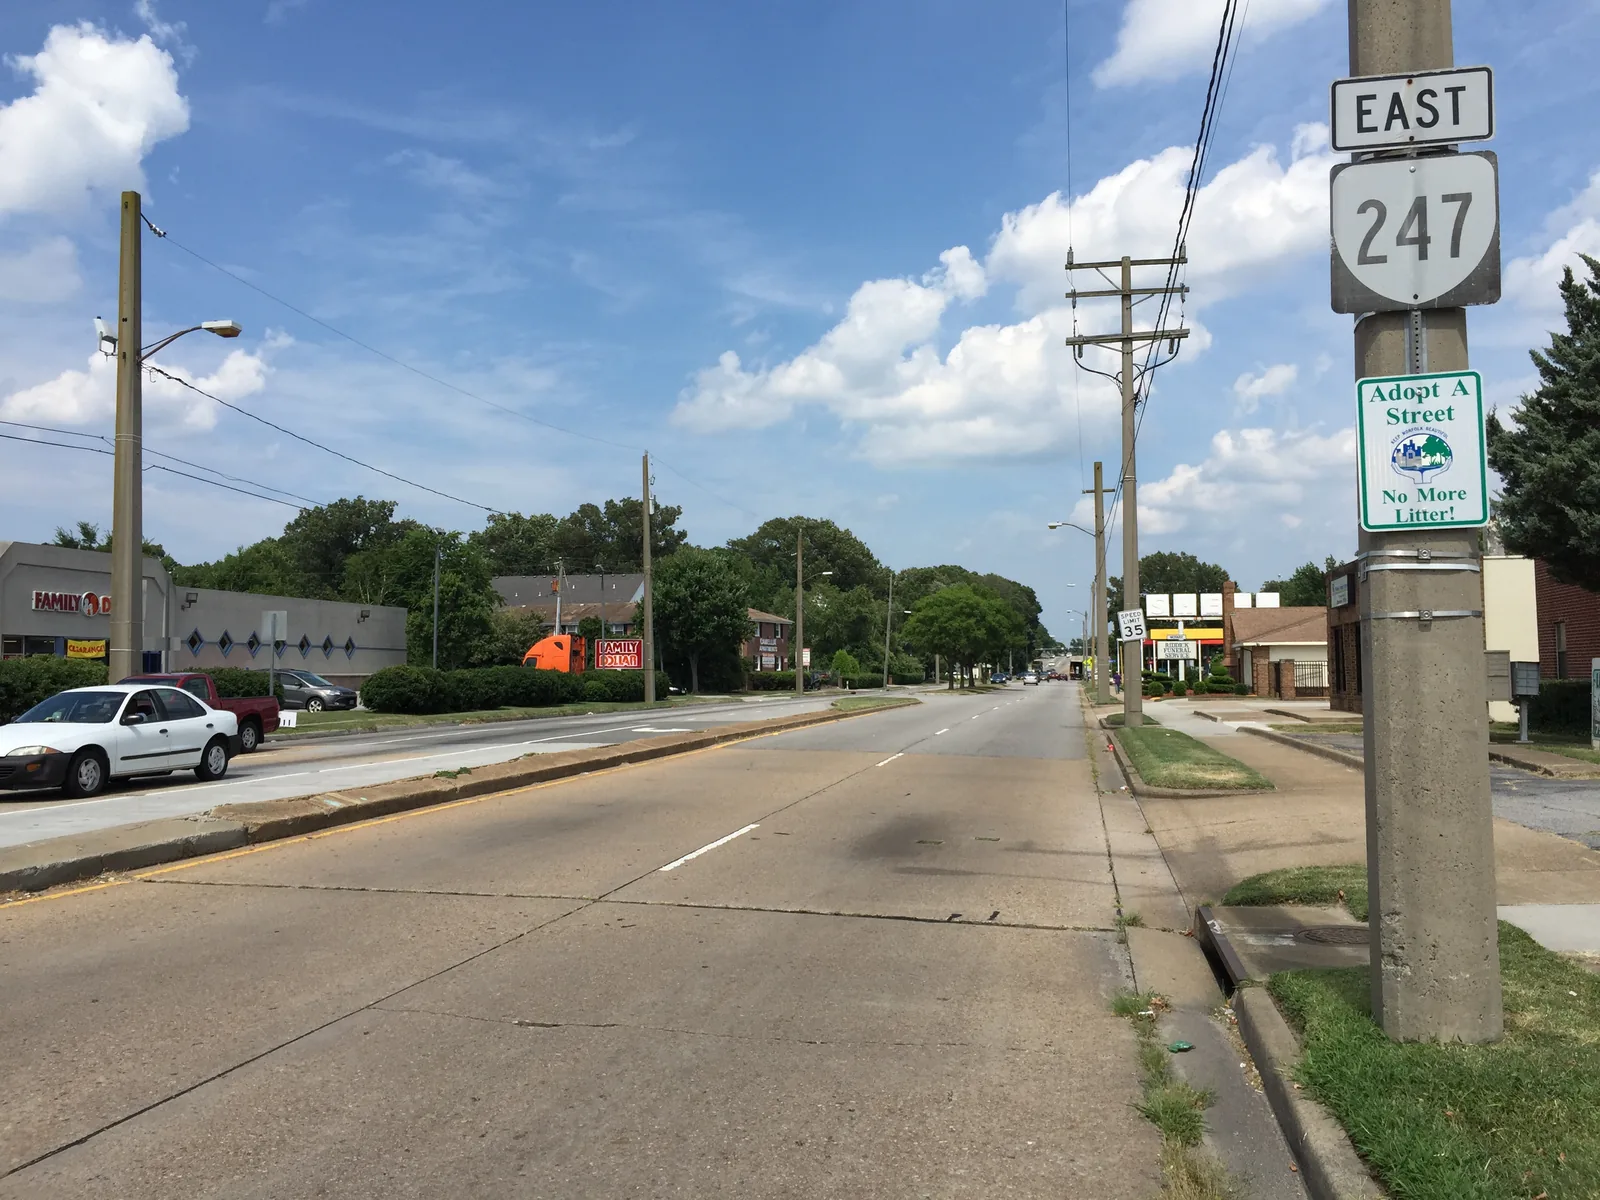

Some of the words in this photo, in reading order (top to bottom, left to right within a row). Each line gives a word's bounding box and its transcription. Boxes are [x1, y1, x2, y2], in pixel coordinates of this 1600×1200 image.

[1356, 86, 1466, 133] EAST
[1357, 192, 1472, 265] 247
[1369, 381, 1440, 404] Adopt
[1451, 379, 1470, 396] A
[1386, 405, 1455, 425] Street
[1402, 426, 1423, 435] NORFOLK
[1382, 489, 1408, 504] No
[1417, 487, 1467, 503] More
[1395, 506, 1455, 523] Litter!
[33, 591, 81, 612] FAMILY
[1120, 611, 1141, 620] SPEED
[1123, 617, 1140, 625] LIMIT
[1124, 624, 1143, 637] 35
